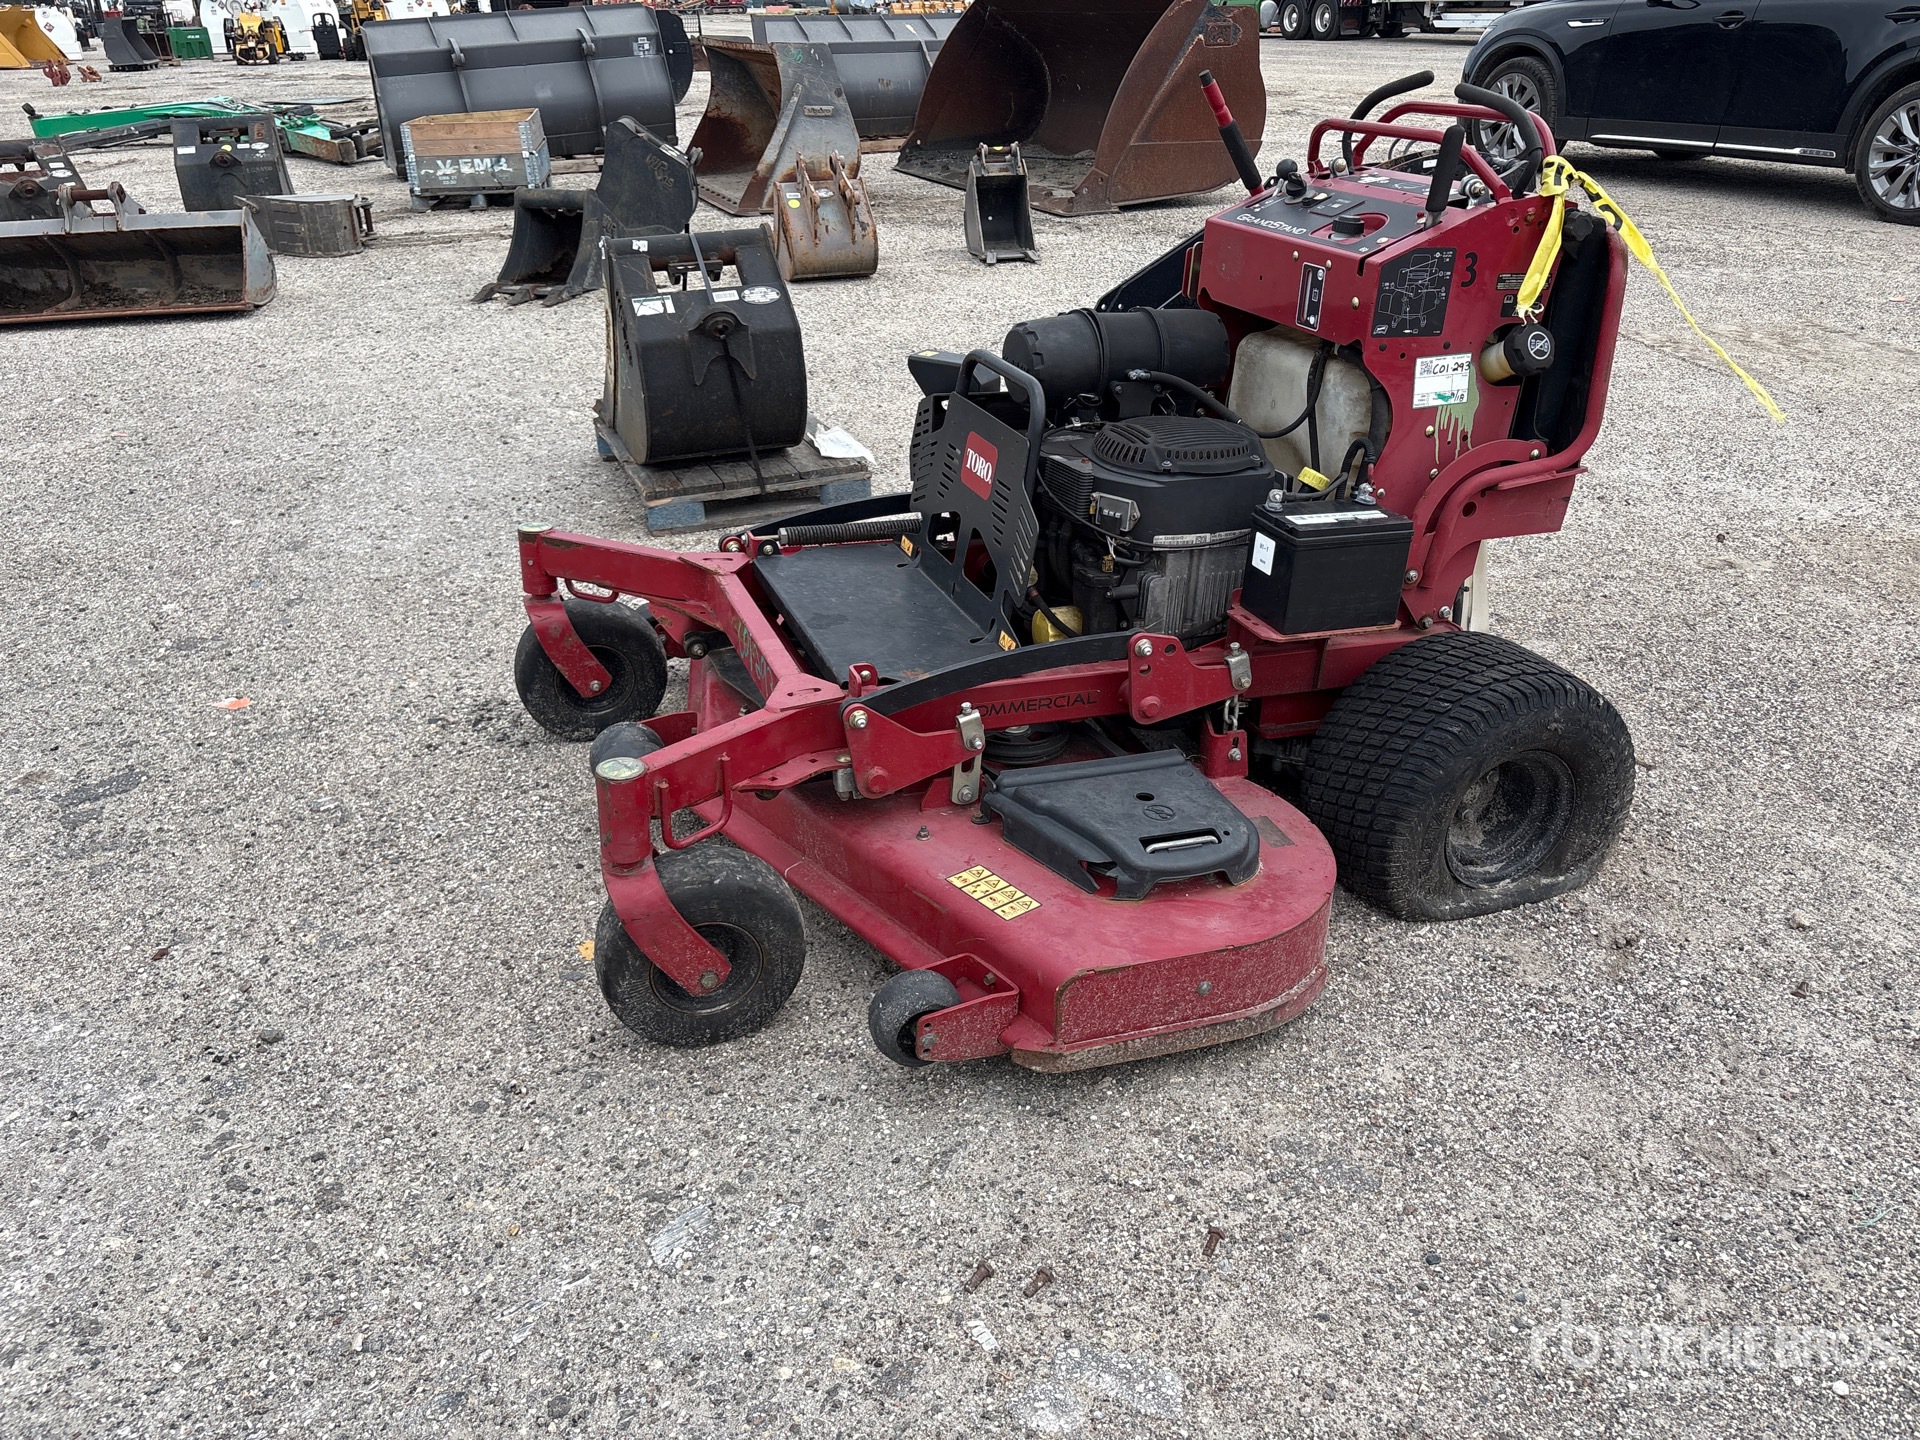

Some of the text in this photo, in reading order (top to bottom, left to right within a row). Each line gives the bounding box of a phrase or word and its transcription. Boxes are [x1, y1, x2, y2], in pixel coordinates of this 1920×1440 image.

[1460, 252, 1478, 288] 3
[965, 448, 993, 483] TORO
[974, 692, 1098, 717] OMMERCIAL
